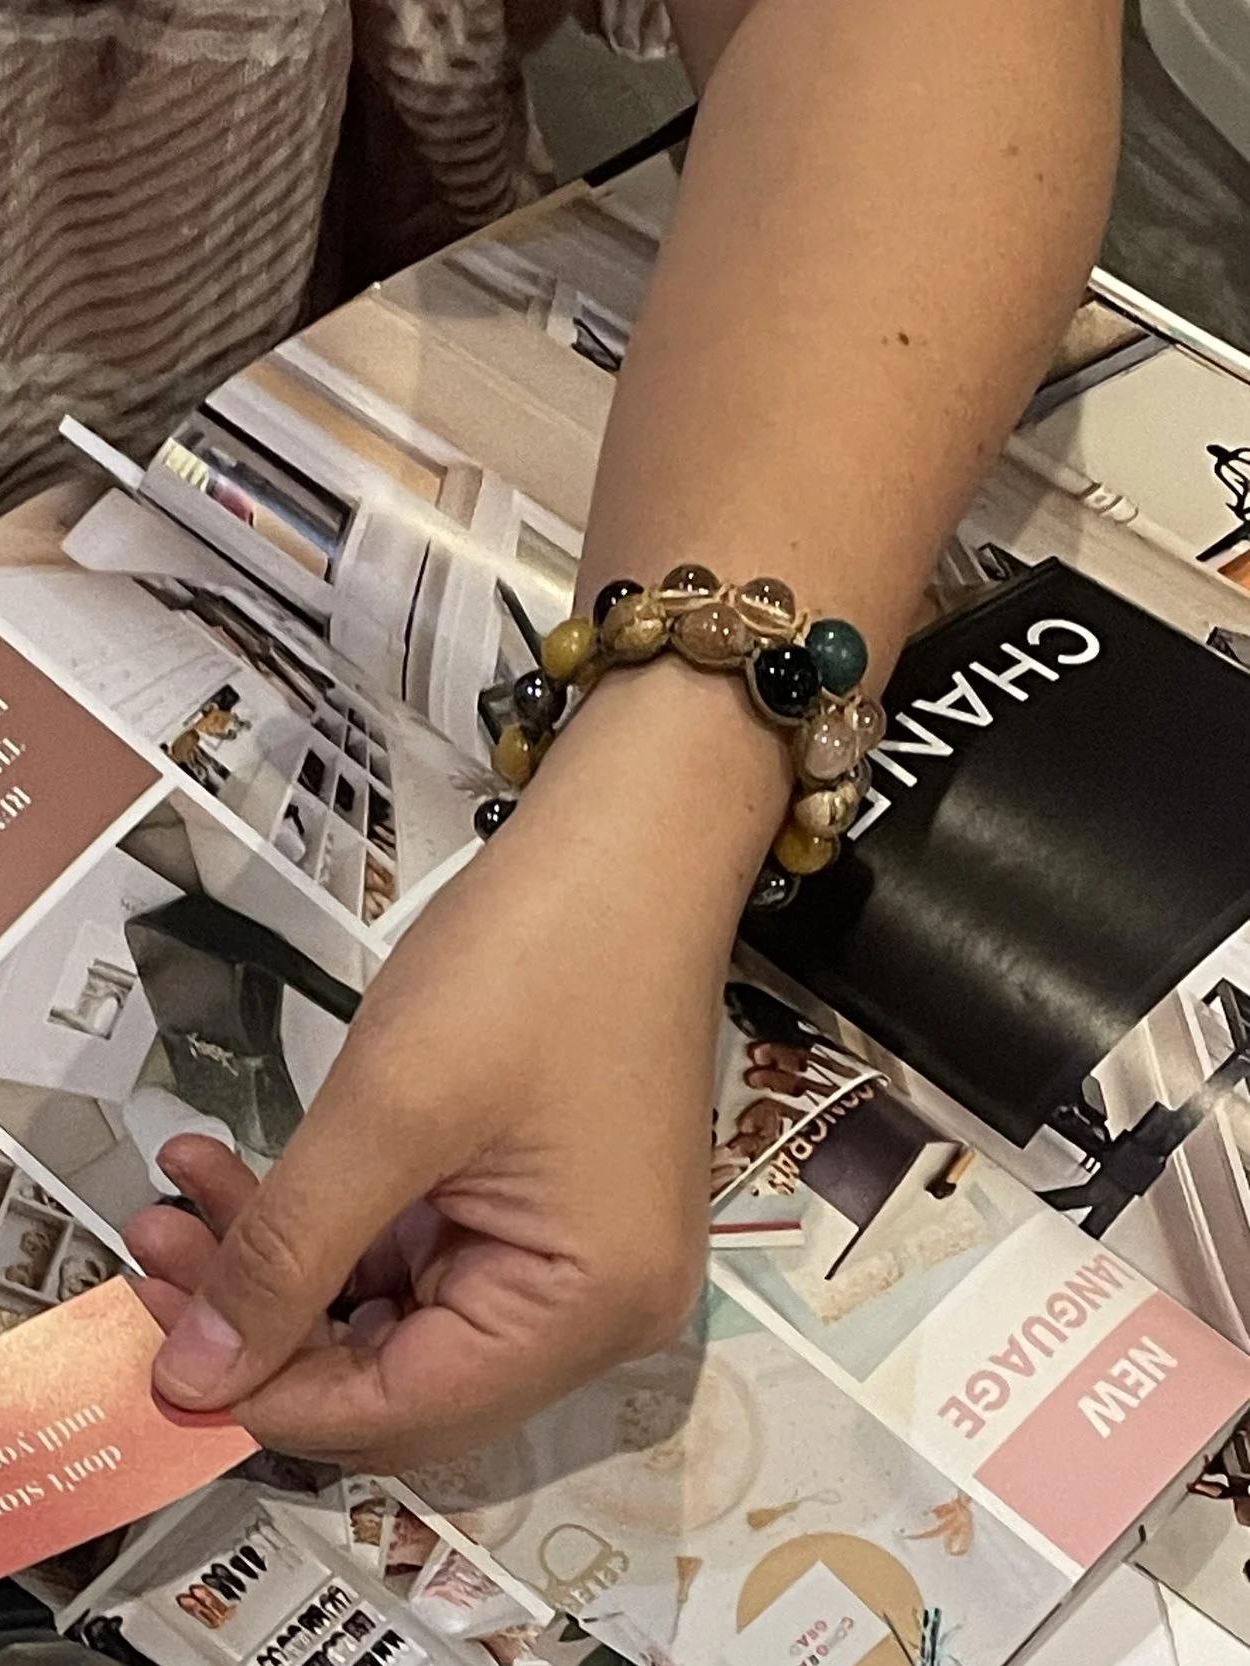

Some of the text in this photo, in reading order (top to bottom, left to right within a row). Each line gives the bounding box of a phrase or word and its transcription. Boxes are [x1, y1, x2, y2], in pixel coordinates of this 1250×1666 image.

[940, 1254, 1132, 1440] LANGUAGE
[1078, 1336, 1177, 1438] NEW
[37, 1403, 106, 1451] until
[48, 1446, 121, 1491] don't
